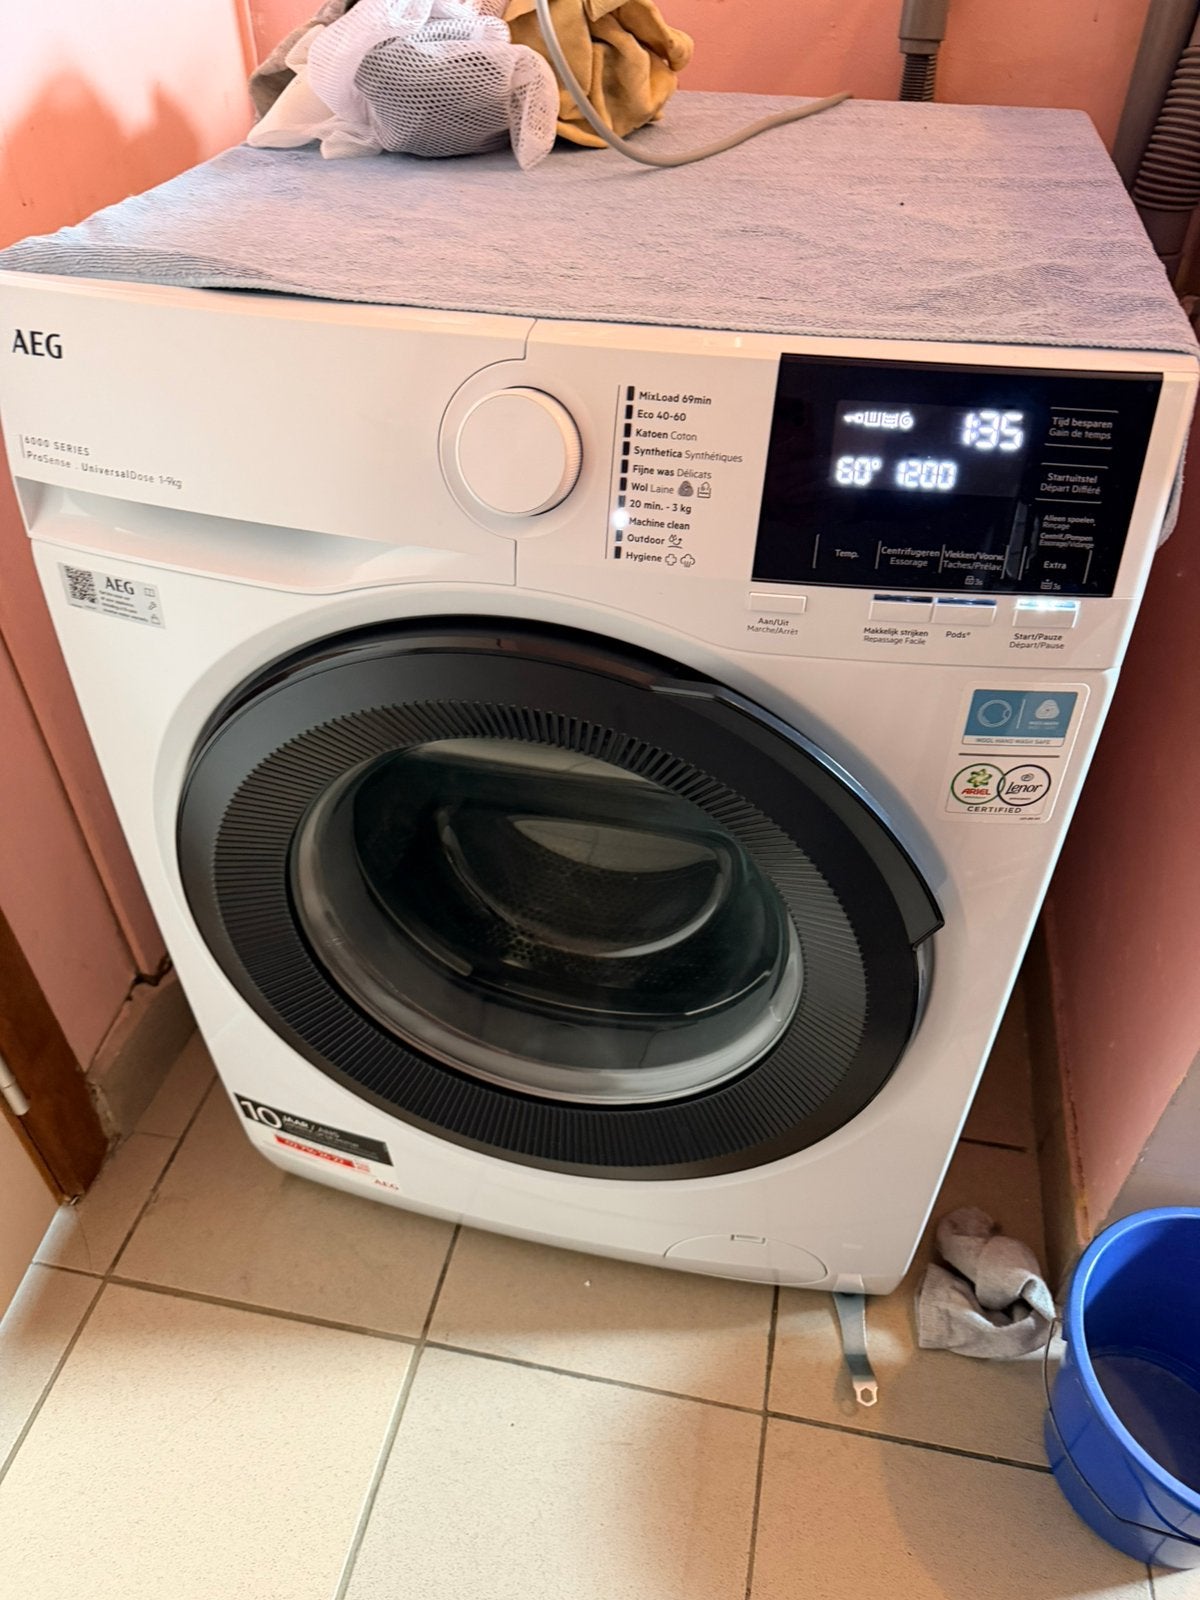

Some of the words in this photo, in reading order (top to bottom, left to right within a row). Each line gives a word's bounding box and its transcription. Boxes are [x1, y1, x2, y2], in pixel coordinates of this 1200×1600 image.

[12, 328, 63, 359] AEG
[639, 391, 680, 403] MixLoad
[682, 395, 712, 405] 69min
[637, 409, 654, 419] Eco
[656, 411, 687, 421] 40-60
[1052, 416, 1070, 427] Tijd
[1071, 418, 1113, 429] besparen
[635, 428, 668, 440] Katoen
[670, 431, 698, 442] Coton
[1049, 428, 1069, 437] Gain
[1071, 430, 1082, 438] de
[1084, 431, 1111, 441] temps
[24, 436, 50, 448] 6000
[53, 441, 90, 456] SERIES
[634, 446, 682, 459] Synthetica
[684, 450, 743, 464] Synthétiques
[26, 450, 71, 469] ProSense
[81, 462, 155, 484] UniversalDose
[632, 465, 655, 476] Fijne
[657, 468, 675, 477] was
[677, 468, 712, 480] Délicats
[896, 460, 958, 490] 1200
[1047, 472, 1098, 484] Startuitstel
[631, 482, 648, 492] Wol
[650, 484, 675, 495] Laine
[1040, 482, 1070, 494] Départ
[1071, 485, 1101, 495] Différé
[629, 499, 641, 508] 20
[644, 501, 664, 511] min.
[672, 503, 679, 512] 3
[680, 504, 692, 515] kg
[628, 517, 666, 529] Machine
[667, 520, 690, 531] clean
[627, 533, 666, 545] Outdoor
[626, 551, 663, 563] Hygiene
[835, 549, 859, 558] Temp.
[881, 546, 940, 558] Centrifugeren
[890, 556, 929, 568] Essorage
[1043, 560, 1067, 570] Extra
[105, 576, 135, 595] AEG
[757, 617, 789, 628] Aan/Uit
[747, 624, 798, 636] Marche/Arrêt
[864, 627, 898, 637] Makkelijk
[900, 629, 929, 638] strijken
[863, 634, 903, 645] Repassage
[904, 637, 927, 646] Facile
[1014, 632, 1063, 642] Start/Pauze
[1009, 640, 1065, 650] Départ/Pause
[961, 788, 991, 796] ARIEL
[1005, 781, 1043, 795] Lenor
[967, 805, 1022, 814] CERTIFIED
[240, 1101, 282, 1129] 10
